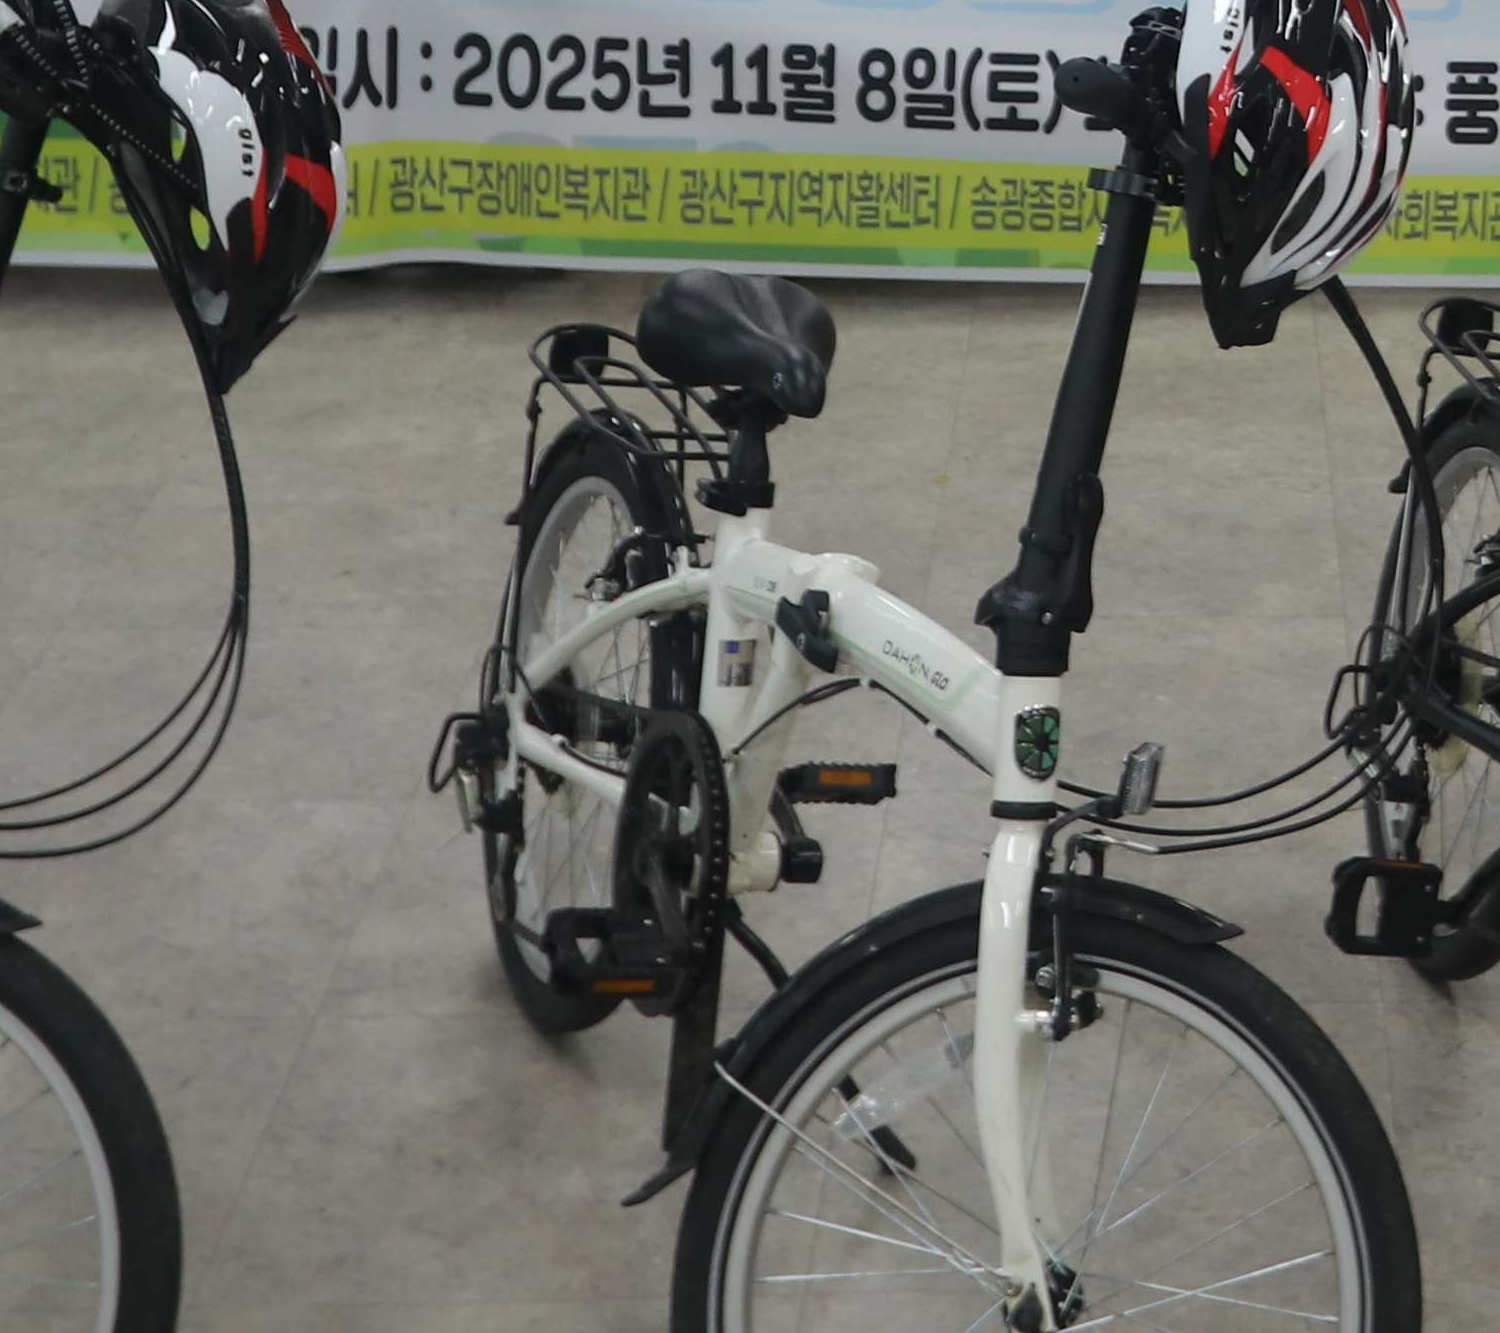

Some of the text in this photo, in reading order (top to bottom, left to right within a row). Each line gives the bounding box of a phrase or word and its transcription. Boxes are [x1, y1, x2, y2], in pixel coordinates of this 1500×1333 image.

[452, 32, 694, 118] 2025년
[710, 41, 837, 124] 11월
[388, 156, 652, 222] 광산구장애인복지관
[678, 169, 940, 229] 광산구지역자활센터
